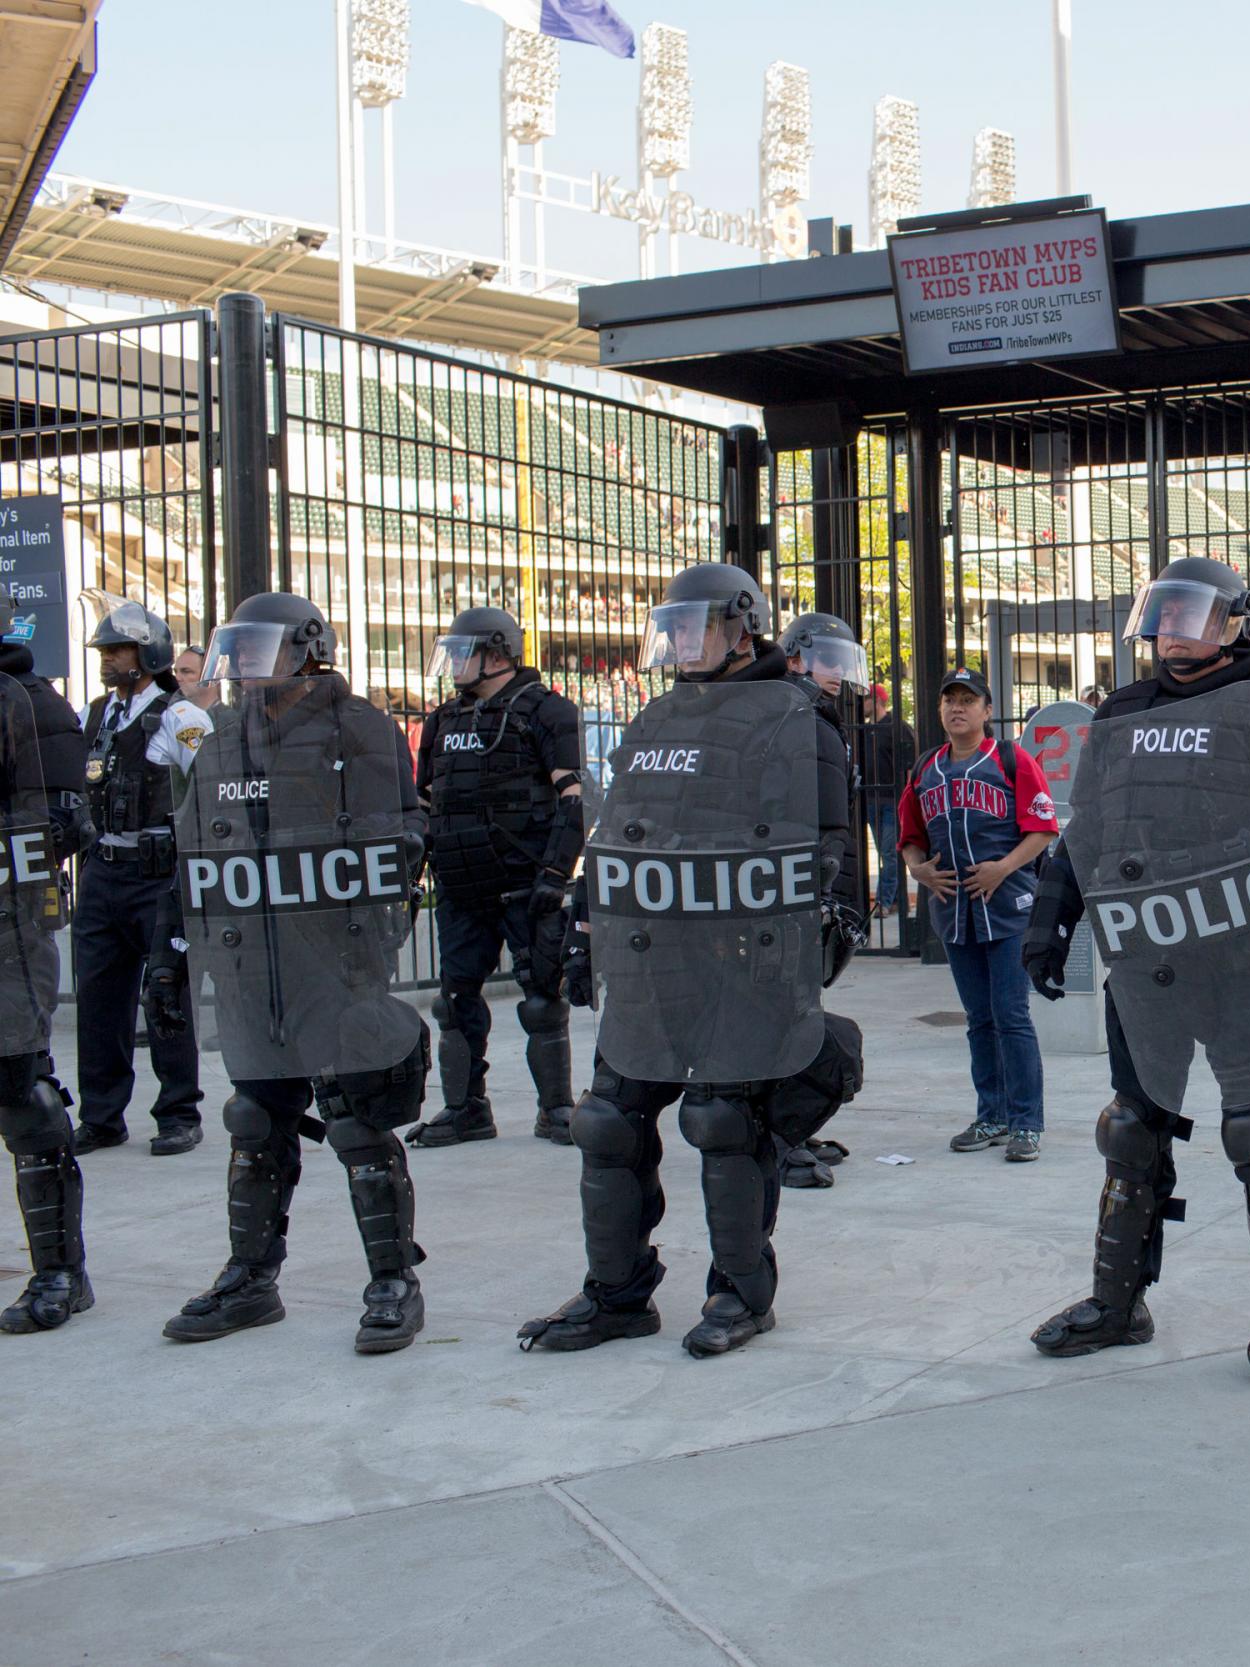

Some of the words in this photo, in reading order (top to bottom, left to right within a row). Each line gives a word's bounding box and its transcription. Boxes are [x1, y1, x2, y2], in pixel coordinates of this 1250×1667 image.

[592, 169, 774, 253] KeyBank
[901, 245, 1027, 280] TRIBETOWN
[1033, 237, 1098, 264] MVPS
[921, 276, 971, 301] KIDS
[977, 271, 1019, 294] FAN
[1026, 263, 1083, 289] CLUB
[909, 302, 993, 323] MEMBERSHIPS
[995, 300, 1019, 314] FOR
[1021, 296, 1047, 311] OUR
[1048, 290, 1103, 308] LITTLEST
[951, 319, 983, 333] FANS
[985, 315, 1009, 329] FOR
[1011, 312, 1040, 327] JUST
[1042, 309, 1063, 324] $25
[1006, 332, 1073, 349] /TribeTownMVPs
[22, 530, 51, 546] Item
[9, 582, 48, 599] Fans.
[1131, 727, 1211, 754] POLICE
[628, 749, 700, 772] POLICE
[218, 780, 269, 801] POLICE
[187, 844, 402, 908] POLICE
[596, 852, 815, 912] POLICE
